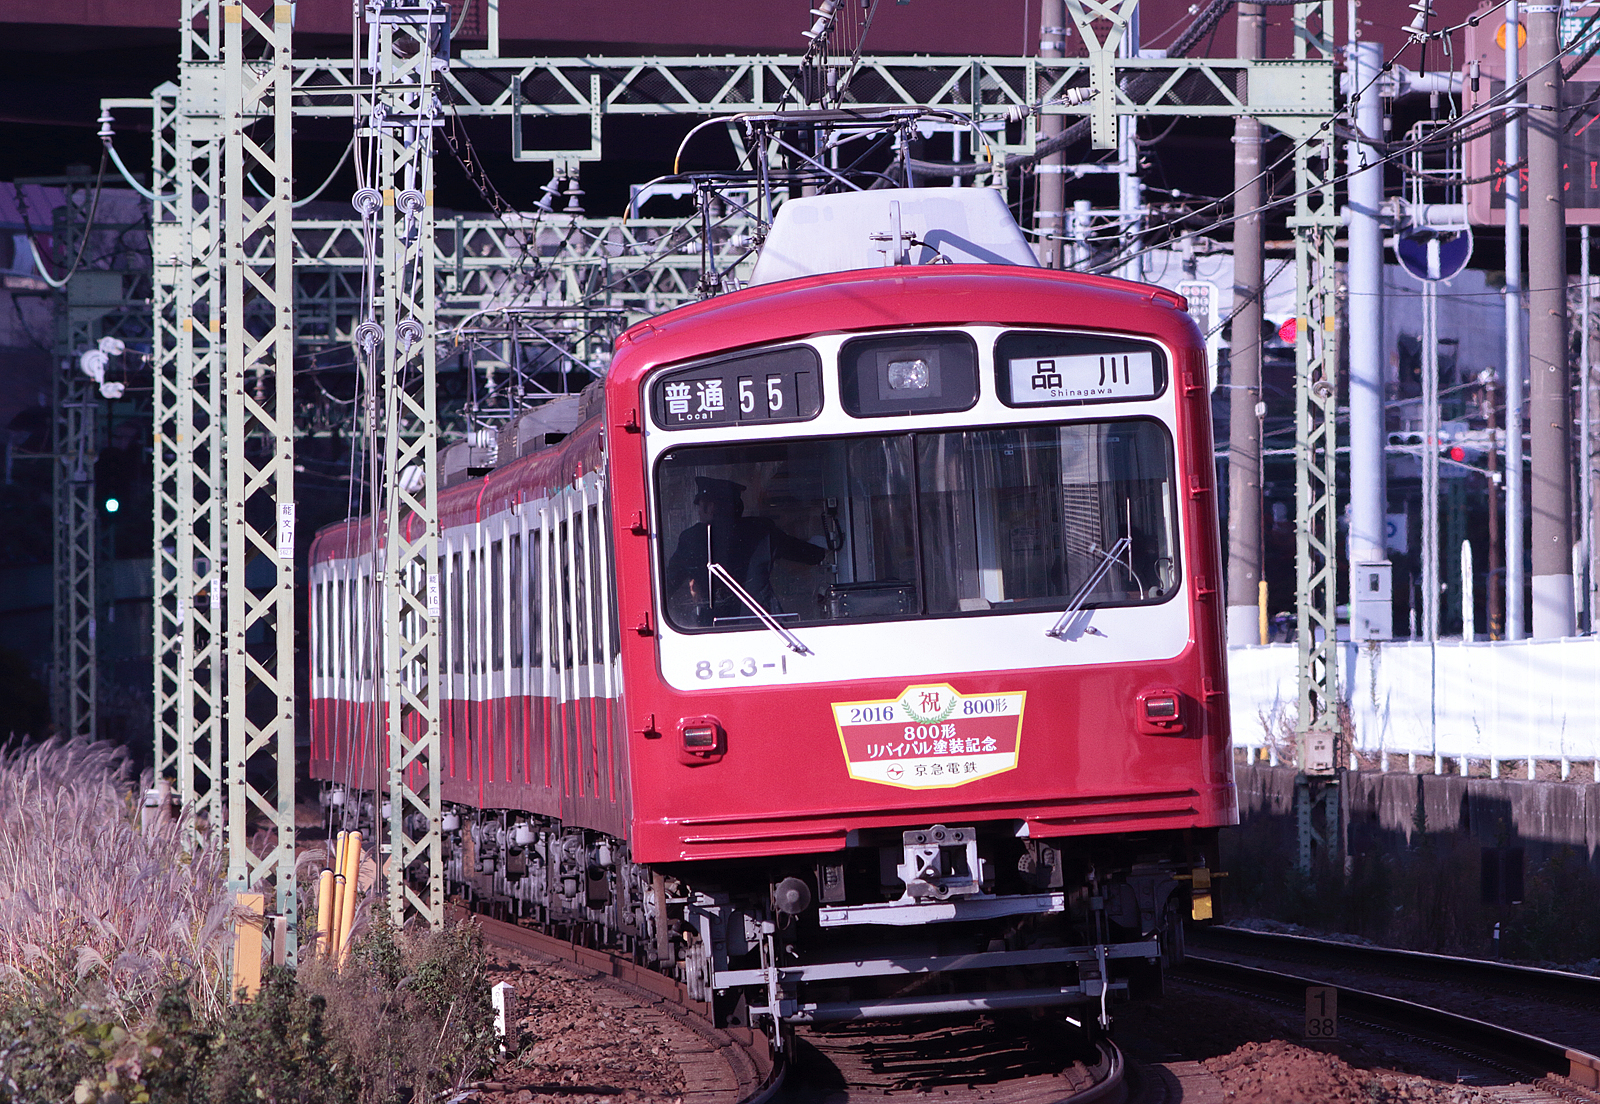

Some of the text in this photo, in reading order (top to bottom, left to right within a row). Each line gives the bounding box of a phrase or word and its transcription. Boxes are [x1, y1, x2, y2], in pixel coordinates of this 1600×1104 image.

[1032, 355, 1129, 390] 品川
[665, 379, 725, 414] 普通
[738, 378, 783, 413] 55
[1050, 387, 1113, 398] Shinagawa
[678, 412, 713, 421] Local
[281, 531, 292, 543] 17
[429, 596, 438, 605] 16
[695, 655, 787, 680] 823-1
[918, 691, 941, 713] 祝
[963, 697, 1008, 715] 800形
[850, 706, 894, 723] 2016
[904, 723, 957, 741] 800形
[867, 736, 997, 759] リバイバル塗装記念
[914, 761, 978, 776] 京急電鉄
[1313, 990, 1326, 1017] 1
[1308, 1018, 1334, 1037] 38
